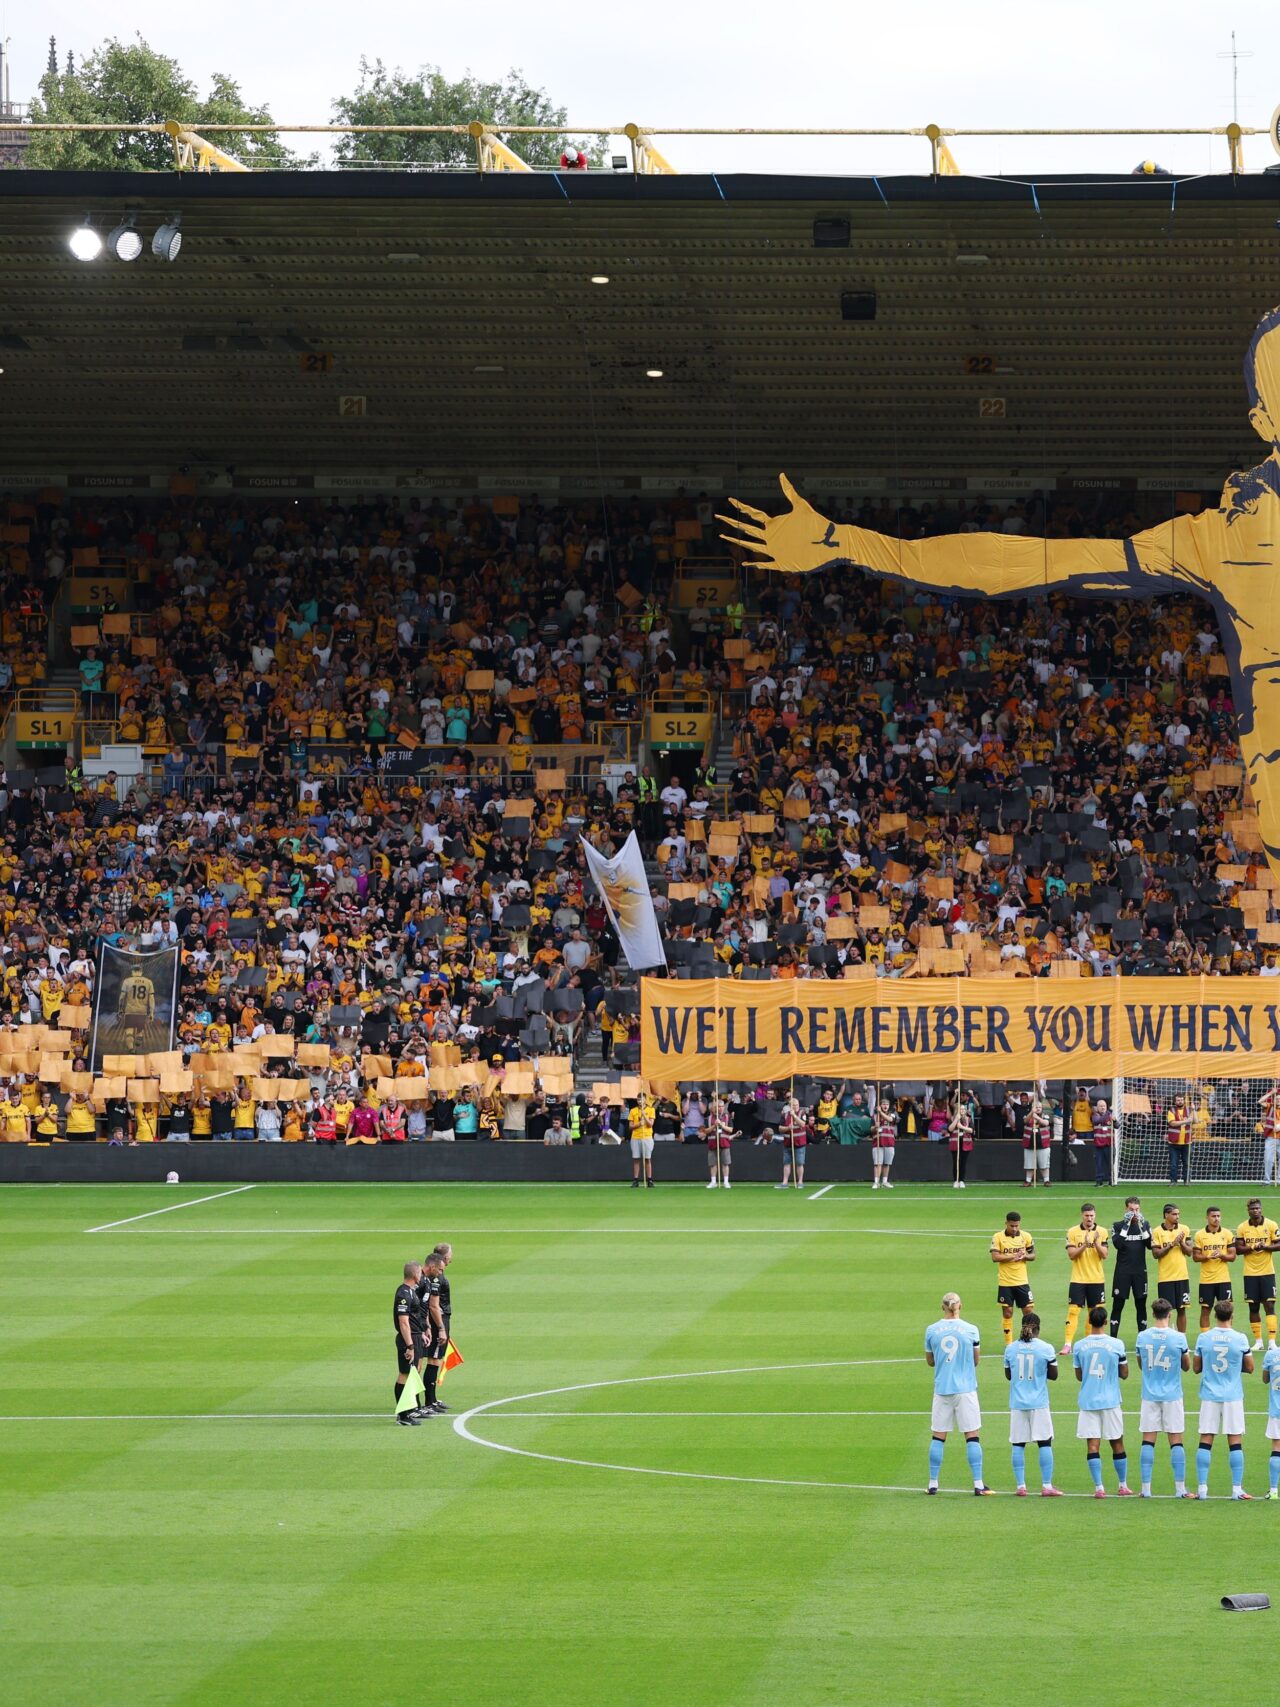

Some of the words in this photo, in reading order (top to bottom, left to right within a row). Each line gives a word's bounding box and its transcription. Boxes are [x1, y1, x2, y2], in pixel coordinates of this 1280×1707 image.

[306, 354, 328, 370] 21
[968, 358, 993, 373] 22
[342, 398, 364, 416] 21
[982, 400, 1004, 418] 22
[90, 586, 110, 599] S1
[698, 588, 718, 601] S2
[31, 721, 62, 735] SL1
[666, 722, 697, 736] SL2
[398, 751, 413, 760] THE
[132, 985, 146, 1000] 18
[652, 1006, 768, 1054] WE'LL
[780, 1004, 1012, 1054] REMEMBER
[1026, 1004, 1112, 1054] YOU
[1128, 1004, 1254, 1053] WHEN
[1028, 1292, 1033, 1300] 8
[1226, 1290, 1231, 1299] 7
[941, 1336, 959, 1362] 9
[1145, 1344, 1171, 1371] 14
[1212, 1346, 1229, 1373] 3
[1017, 1354, 1034, 1380] 11
[1089, 1352, 1105, 1379] 4
